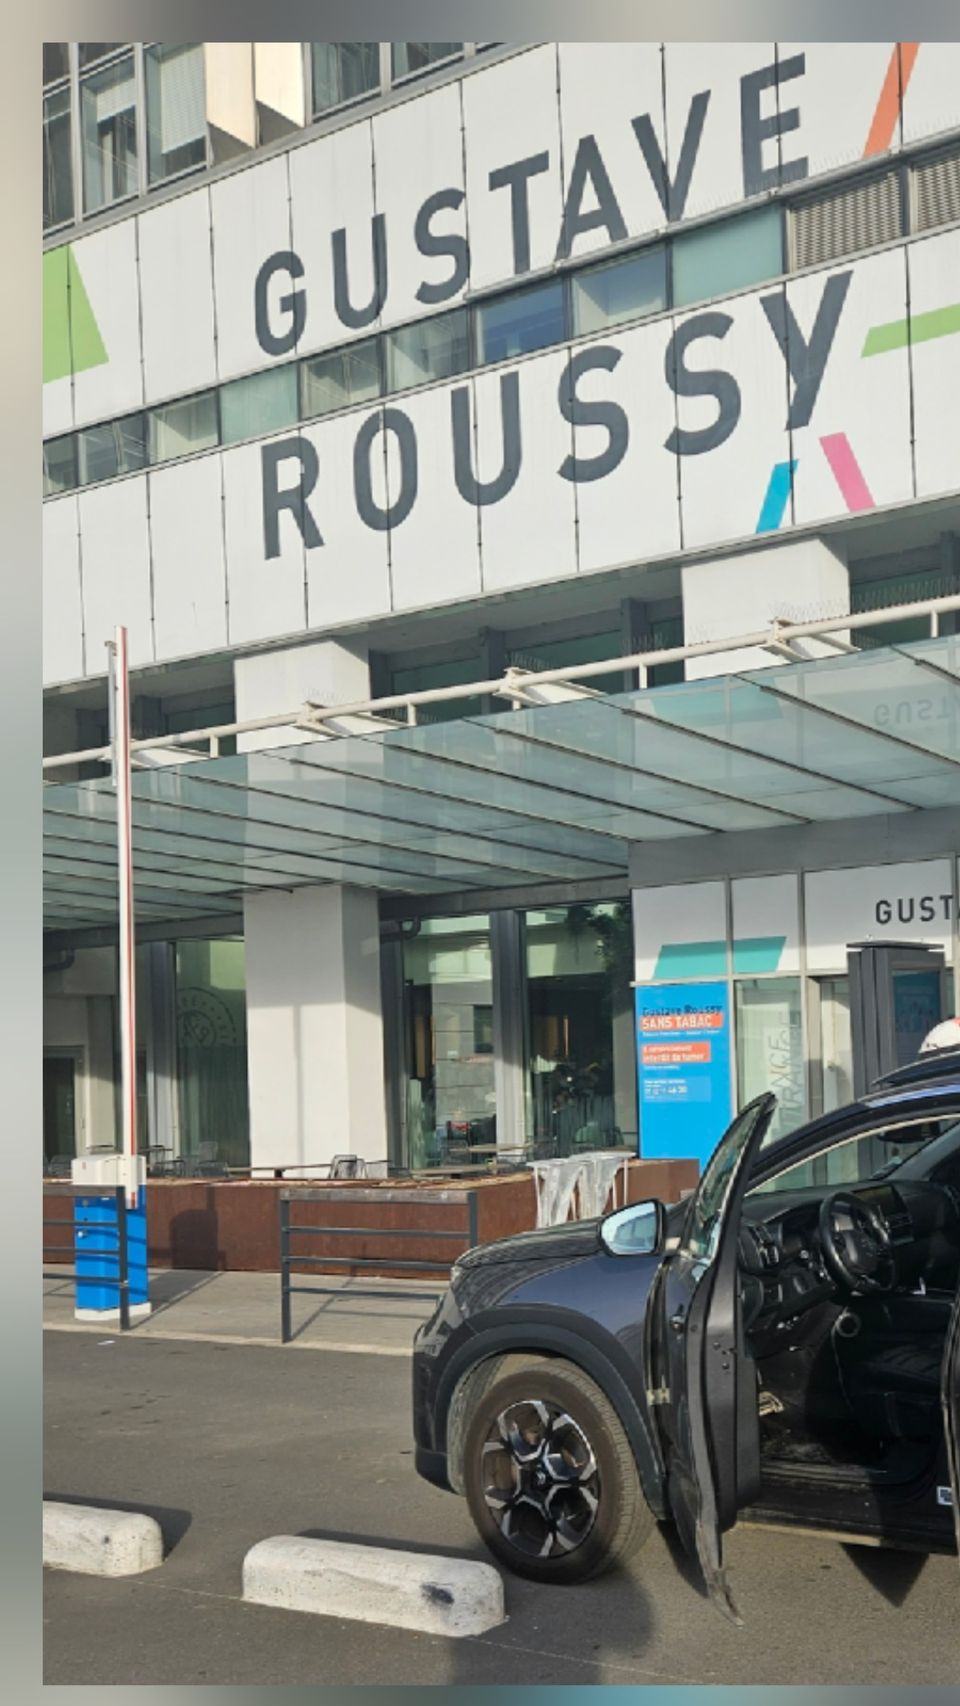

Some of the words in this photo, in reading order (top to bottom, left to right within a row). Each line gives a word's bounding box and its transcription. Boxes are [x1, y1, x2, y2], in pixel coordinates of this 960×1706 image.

[253, 53, 811, 356] GUSTAVE
[261, 270, 854, 560] ROUSSY
[641, 1016, 673, 1030] SANS
[675, 1014, 712, 1028] TABAC
